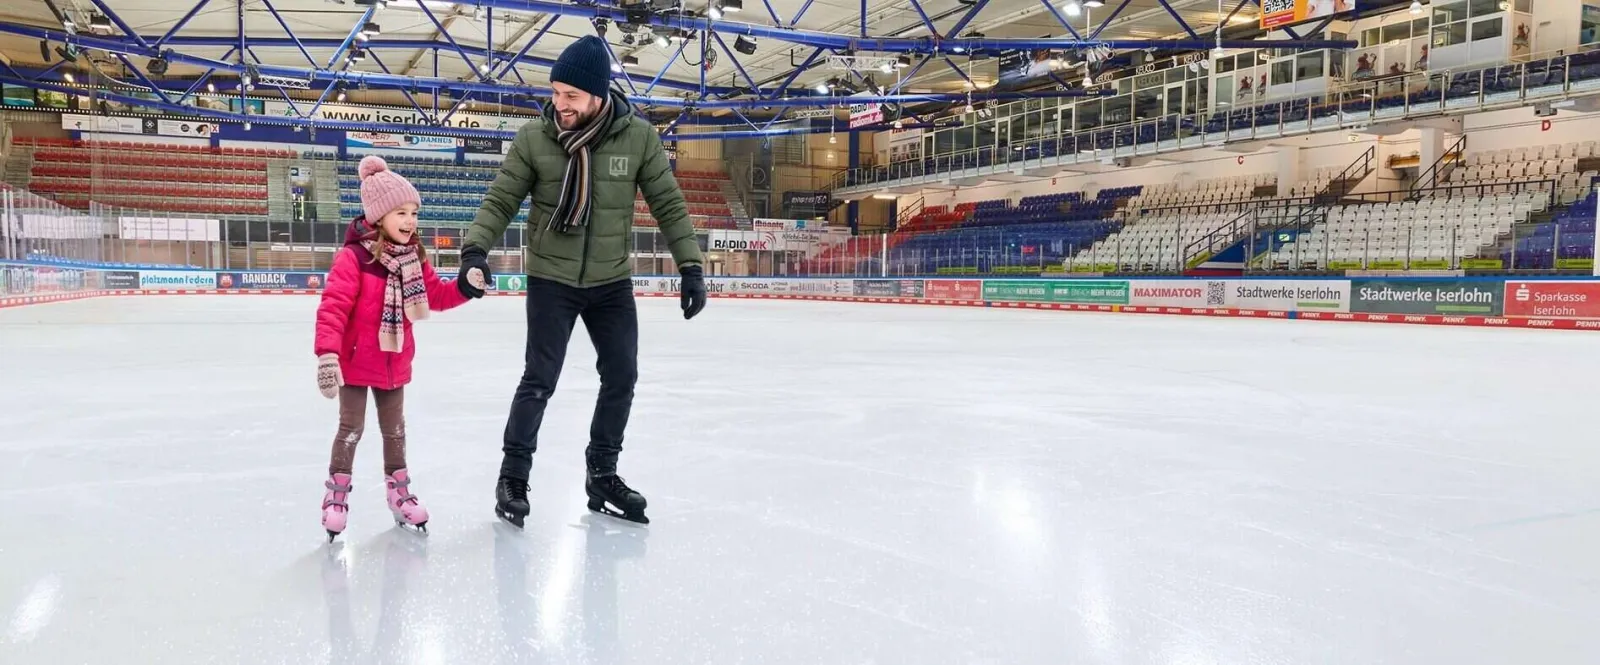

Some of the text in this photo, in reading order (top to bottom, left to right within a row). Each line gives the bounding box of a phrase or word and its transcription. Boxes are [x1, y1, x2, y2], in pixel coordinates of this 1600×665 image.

[322, 110, 480, 129] wwwiserlonde
[1541, 120, 1551, 131] D
[1237, 155, 1244, 165] C
[714, 239, 767, 250] RADIO MK
[242, 273, 287, 284] RANDACK
[670, 278, 724, 292] Krcher
[1134, 288, 1202, 298] MAXIMATOR
[1236, 286, 1341, 300] Stadtwerke Iserlohn
[1360, 286, 1492, 303] Stadtwerke Iserlohn
[1534, 291, 1587, 303] Sparkasse
[1533, 305, 1576, 316] Iserlohn
